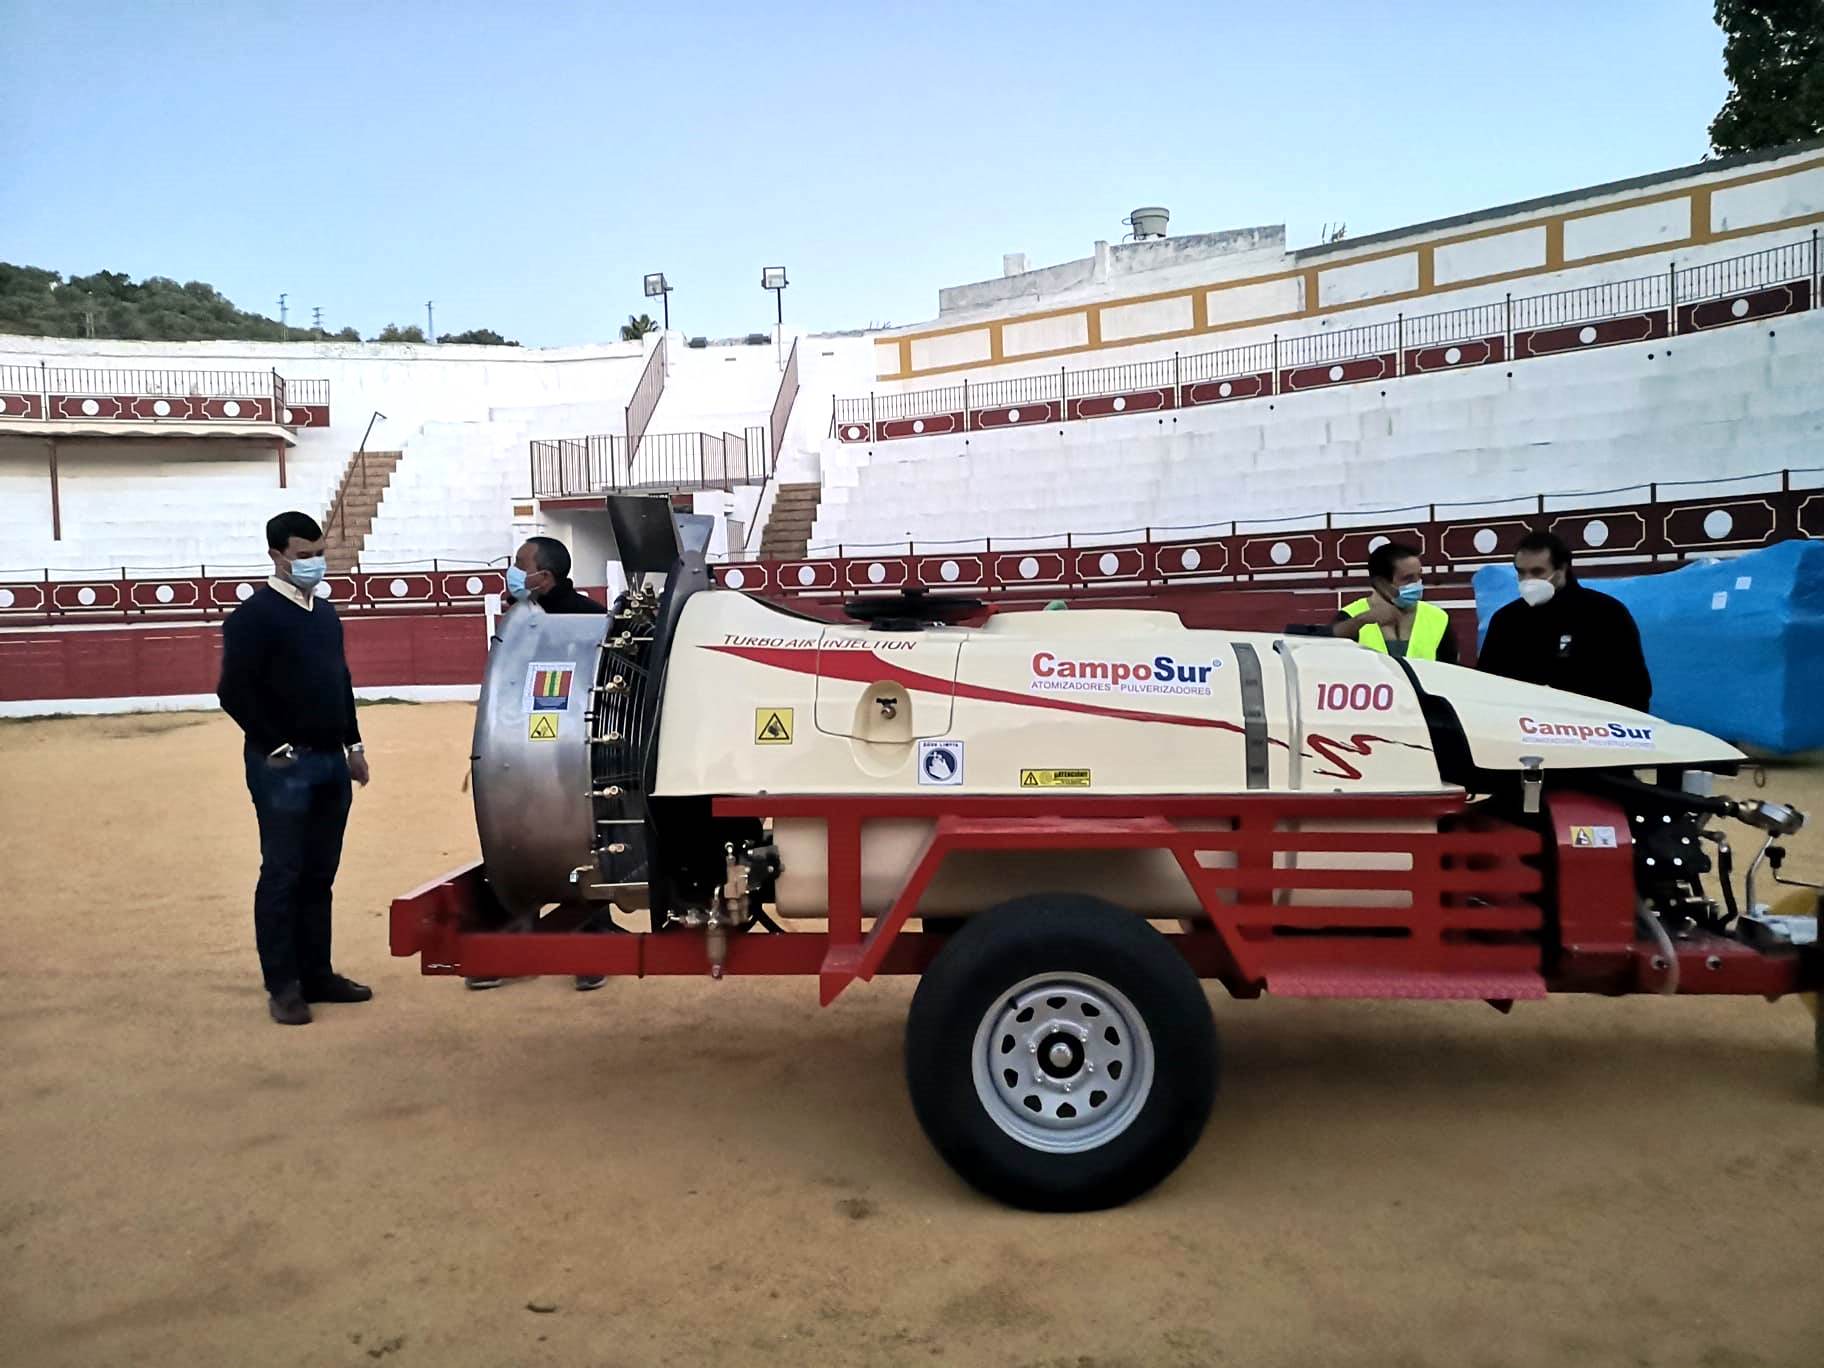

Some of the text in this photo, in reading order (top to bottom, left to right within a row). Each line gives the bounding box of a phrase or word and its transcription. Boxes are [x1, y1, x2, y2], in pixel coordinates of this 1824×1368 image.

[724, 634, 784, 648] TURBO
[822, 639, 917, 651] INJECTION
[1032, 652, 1212, 686] CampoSur
[1031, 680, 1212, 697] ATOMIZADORES PULVERIZADORES
[1317, 683, 1394, 711] 1000
[1519, 716, 1652, 741] CampoSur
